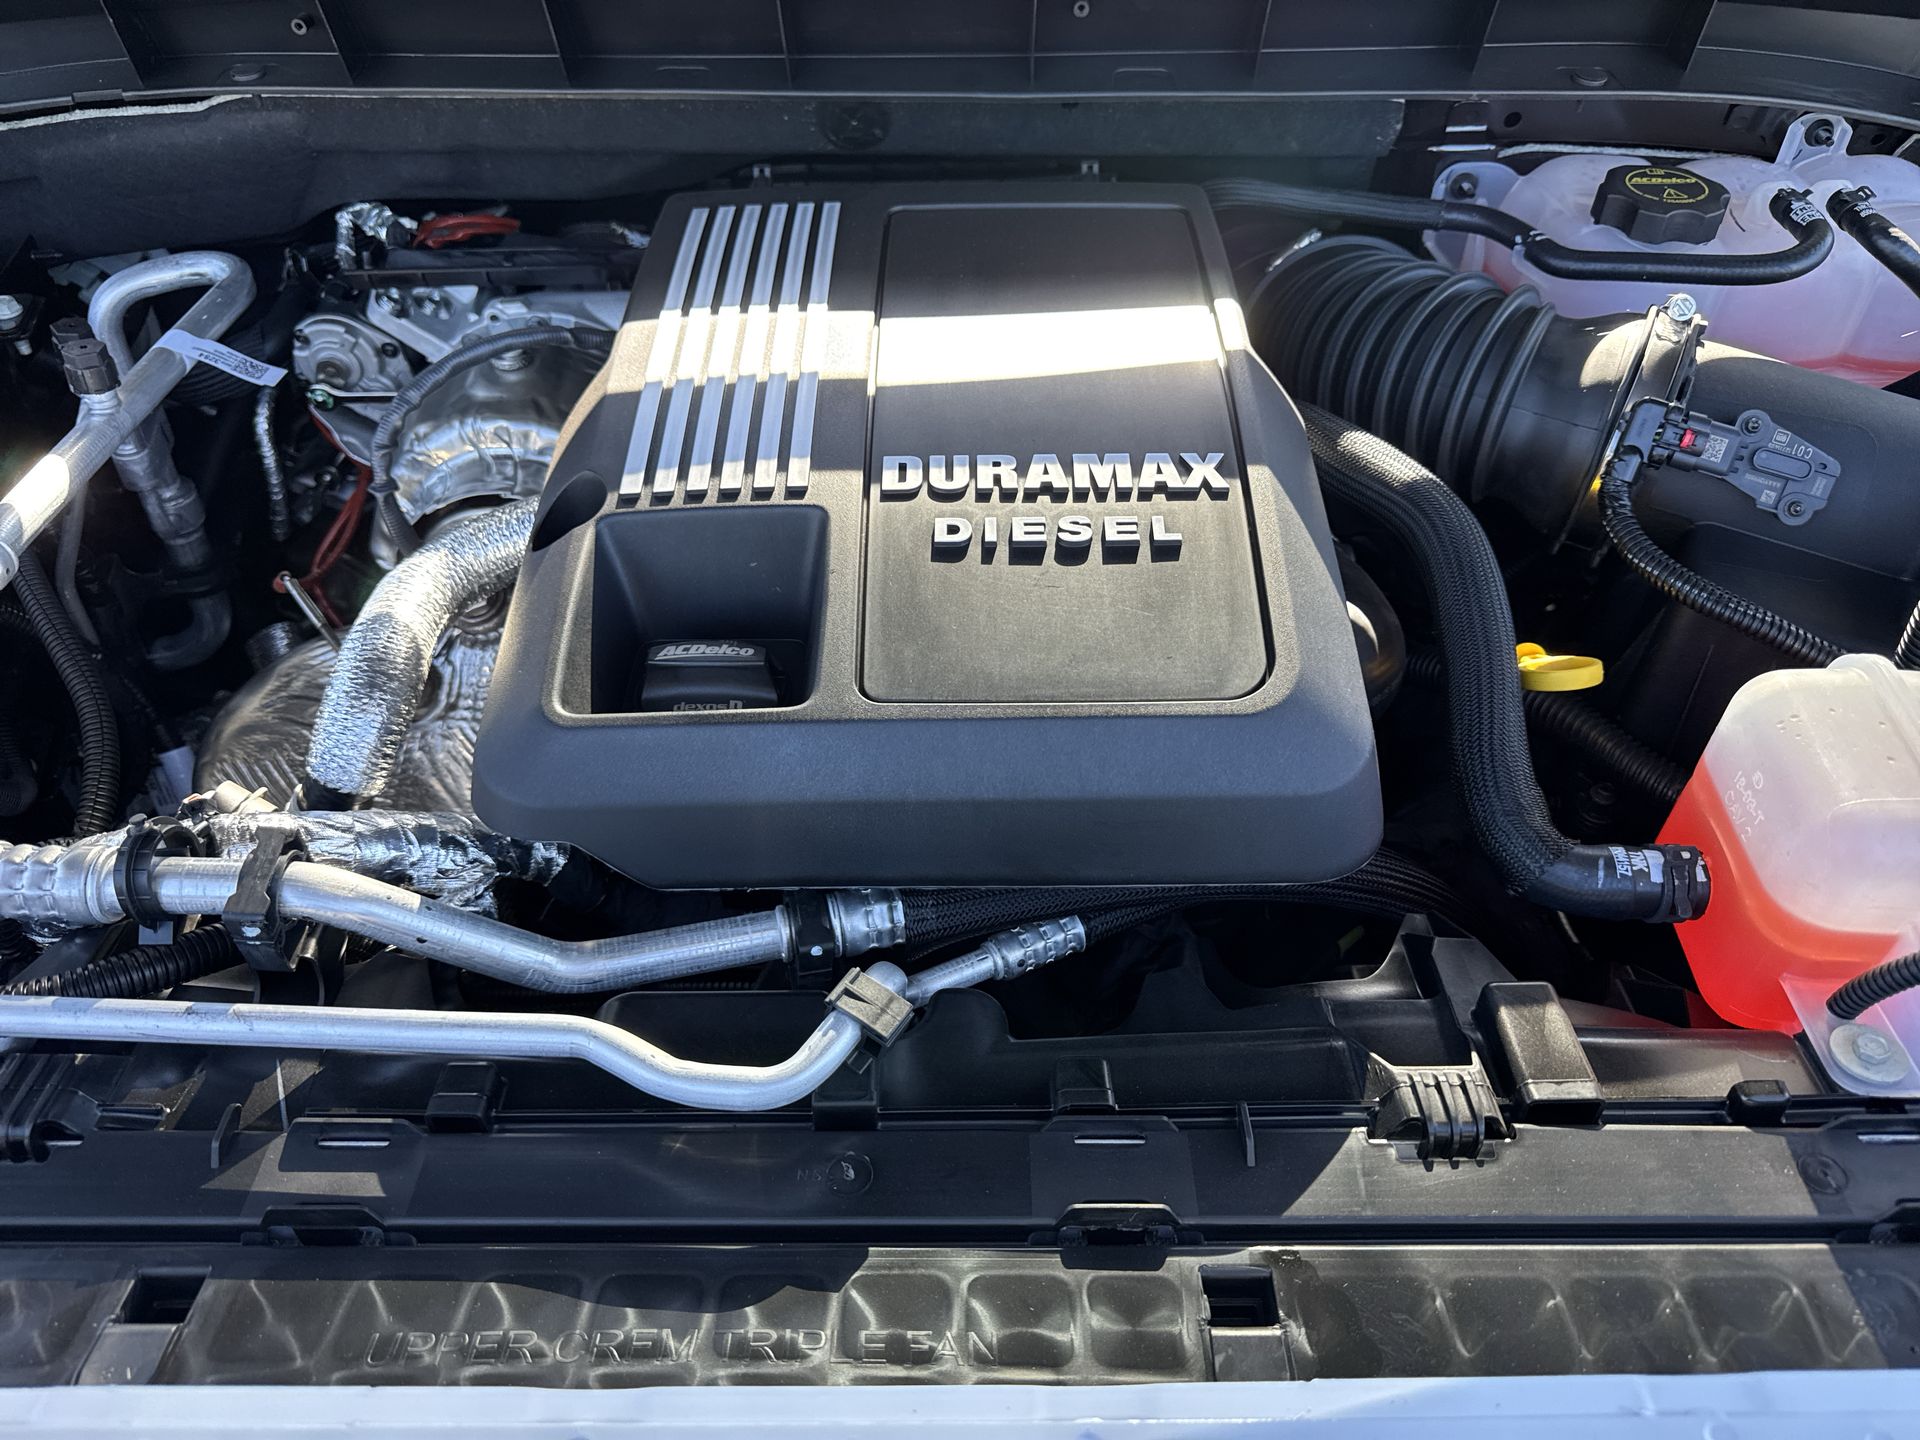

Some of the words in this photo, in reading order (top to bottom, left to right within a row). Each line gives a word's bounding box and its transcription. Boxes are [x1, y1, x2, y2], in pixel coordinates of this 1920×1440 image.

[1630, 176, 1697, 185] ACDelco
[880, 452, 1230, 498] DURAMAX
[933, 515, 1183, 549] DIESEL
[656, 643, 755, 658] ACDelco
[365, 1329, 539, 1367] UPPER
[713, 1328, 888, 1367] TRIPLE
[904, 1330, 999, 1368] FAN
